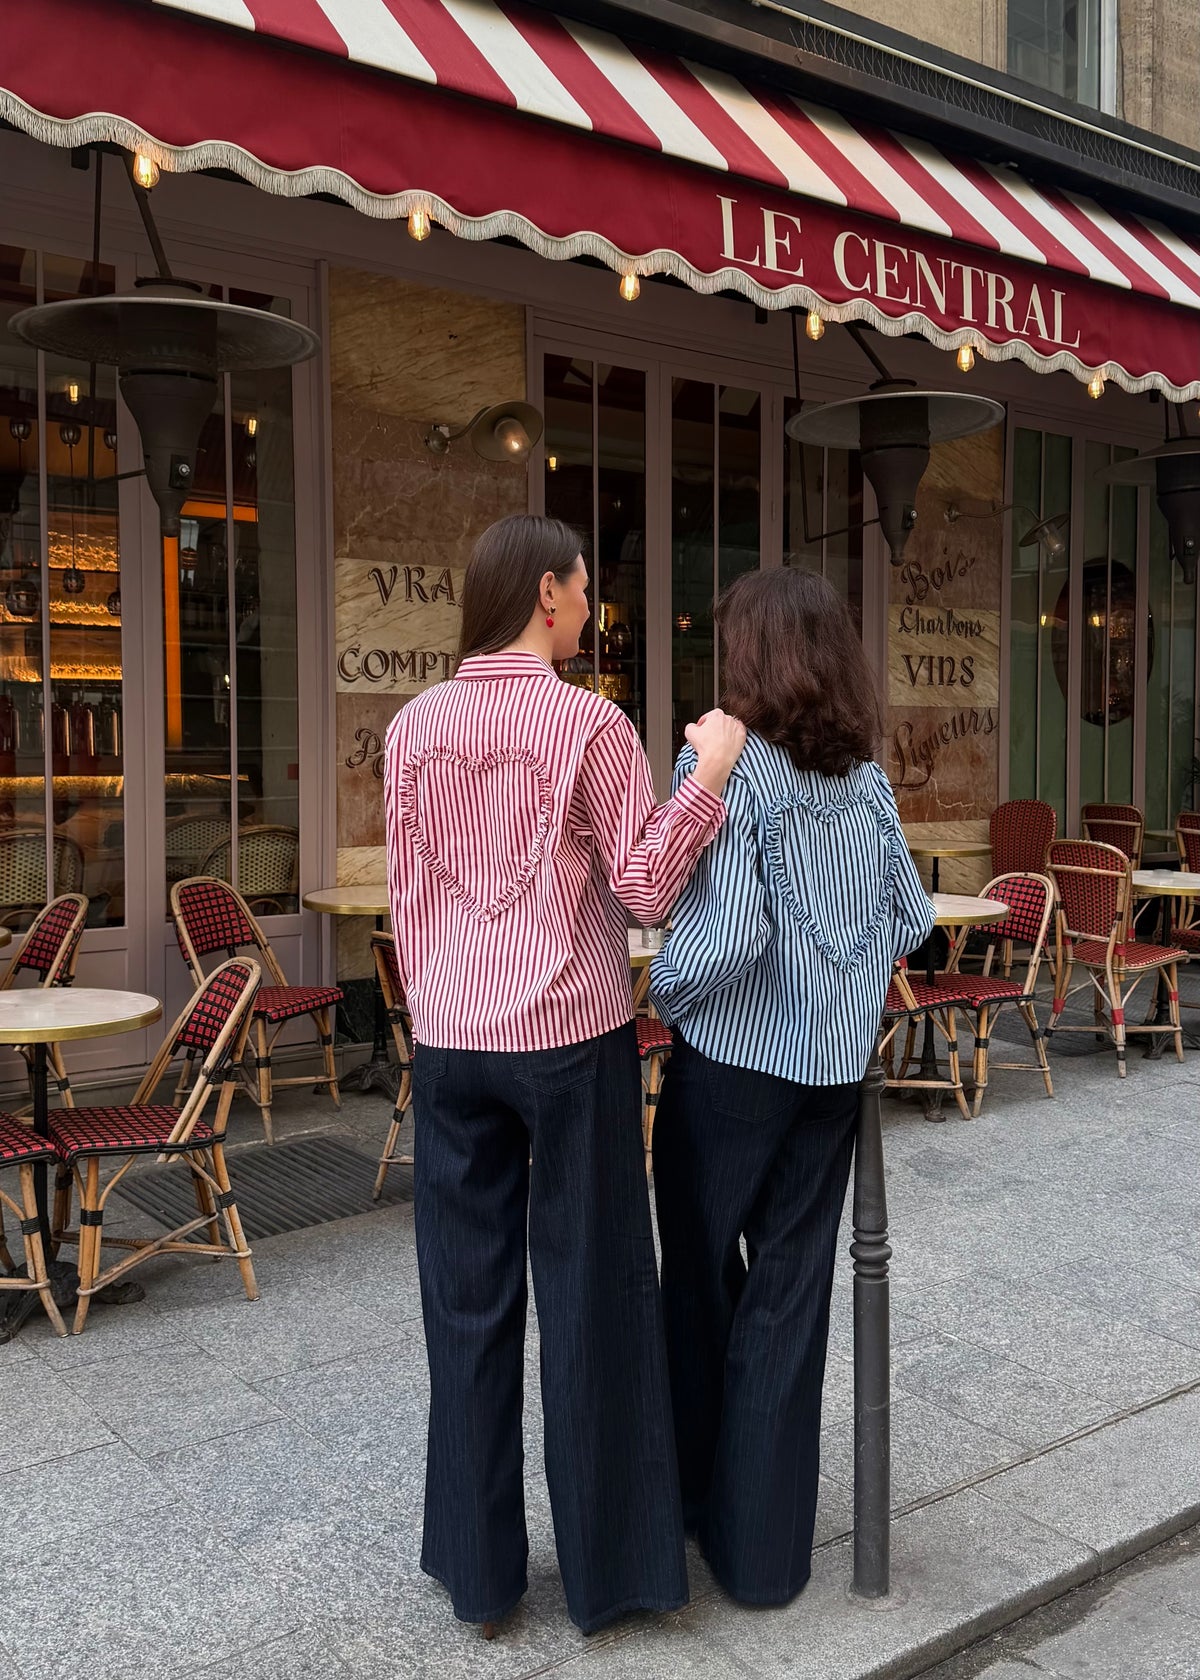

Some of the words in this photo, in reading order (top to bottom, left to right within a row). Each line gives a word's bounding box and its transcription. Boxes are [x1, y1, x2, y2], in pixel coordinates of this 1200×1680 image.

[716, 194, 804, 278] LE
[833, 231, 1080, 348] CENTRAL
[368, 565, 463, 607] VRA
[901, 547, 975, 605] Bois
[898, 606, 985, 639] Charbons
